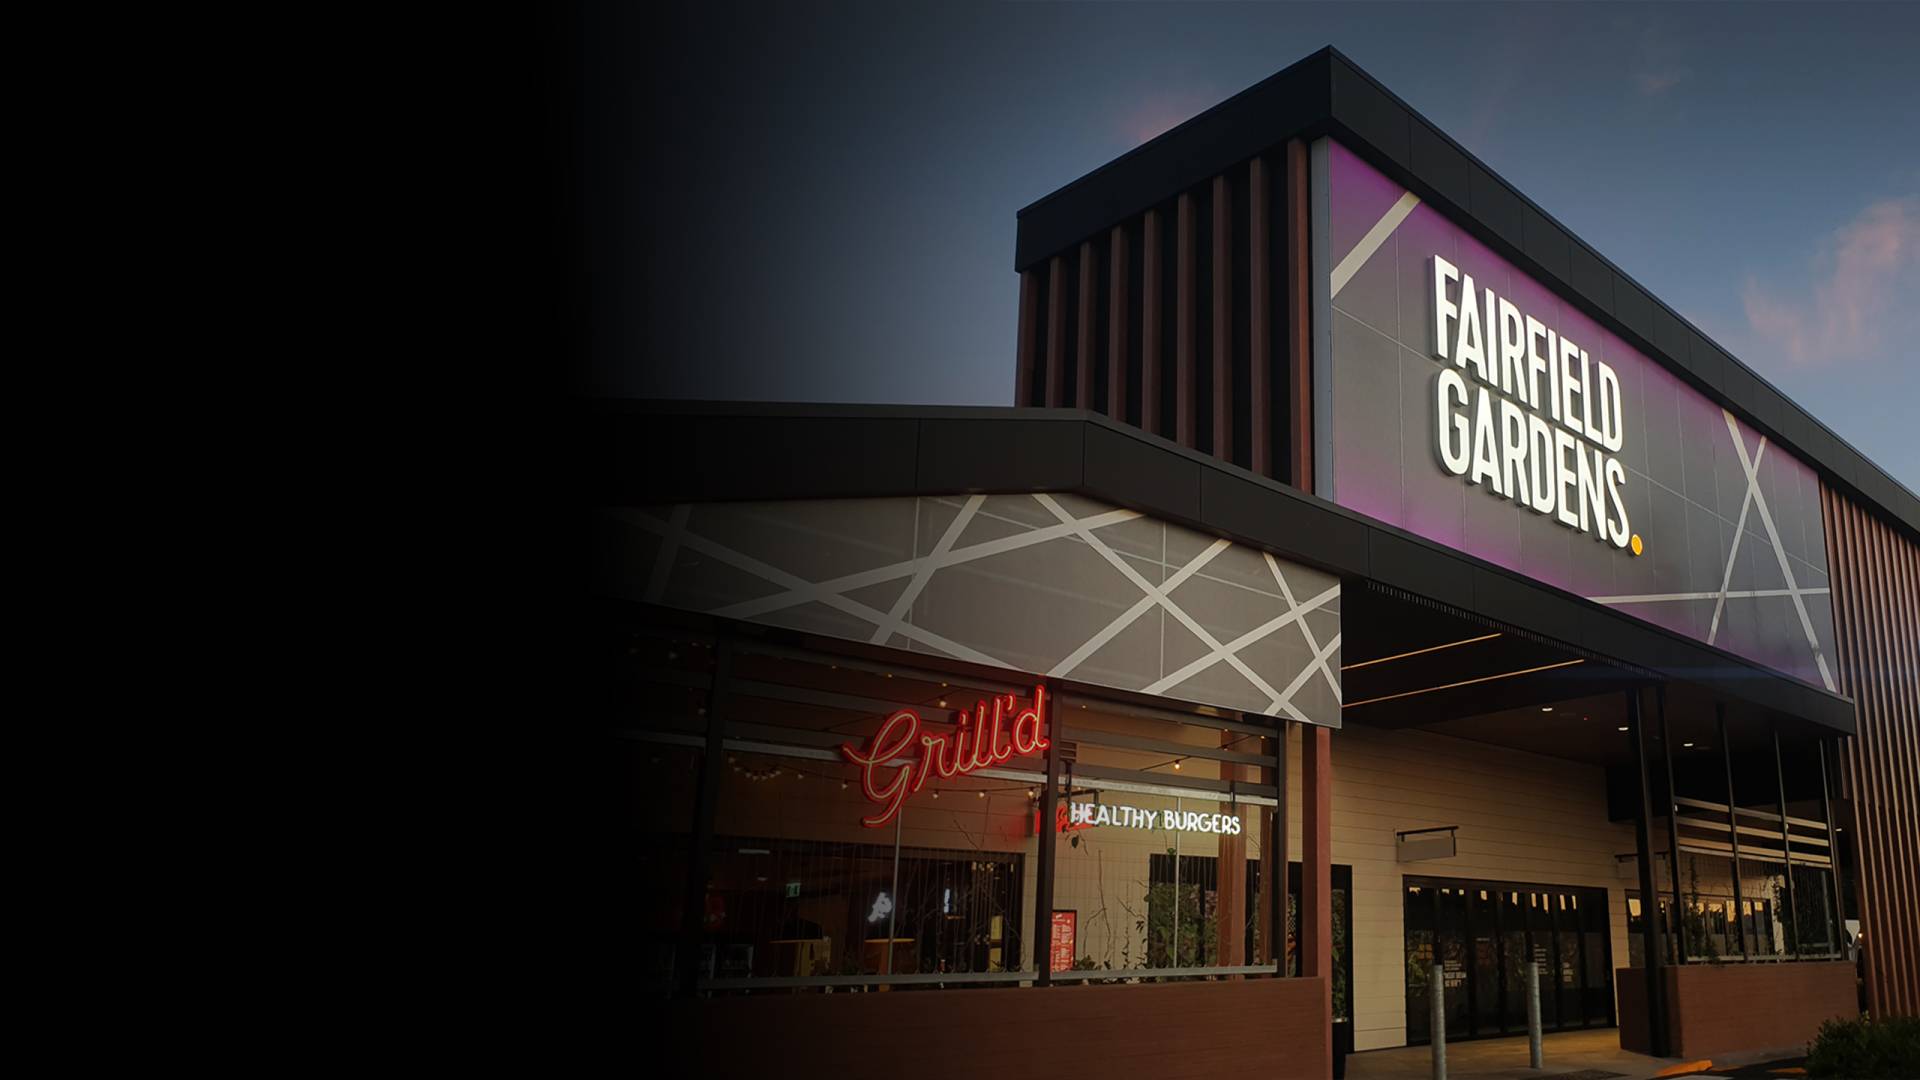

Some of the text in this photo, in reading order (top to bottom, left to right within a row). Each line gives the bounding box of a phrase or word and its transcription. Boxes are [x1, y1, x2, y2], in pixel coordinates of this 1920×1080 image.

[1434, 254, 1624, 453] FAIRFIELD
[842, 685, 1049, 828] Grill'd
[1070, 801, 1158, 831] HEALTHY
[1164, 809, 1241, 835] BURGERS
